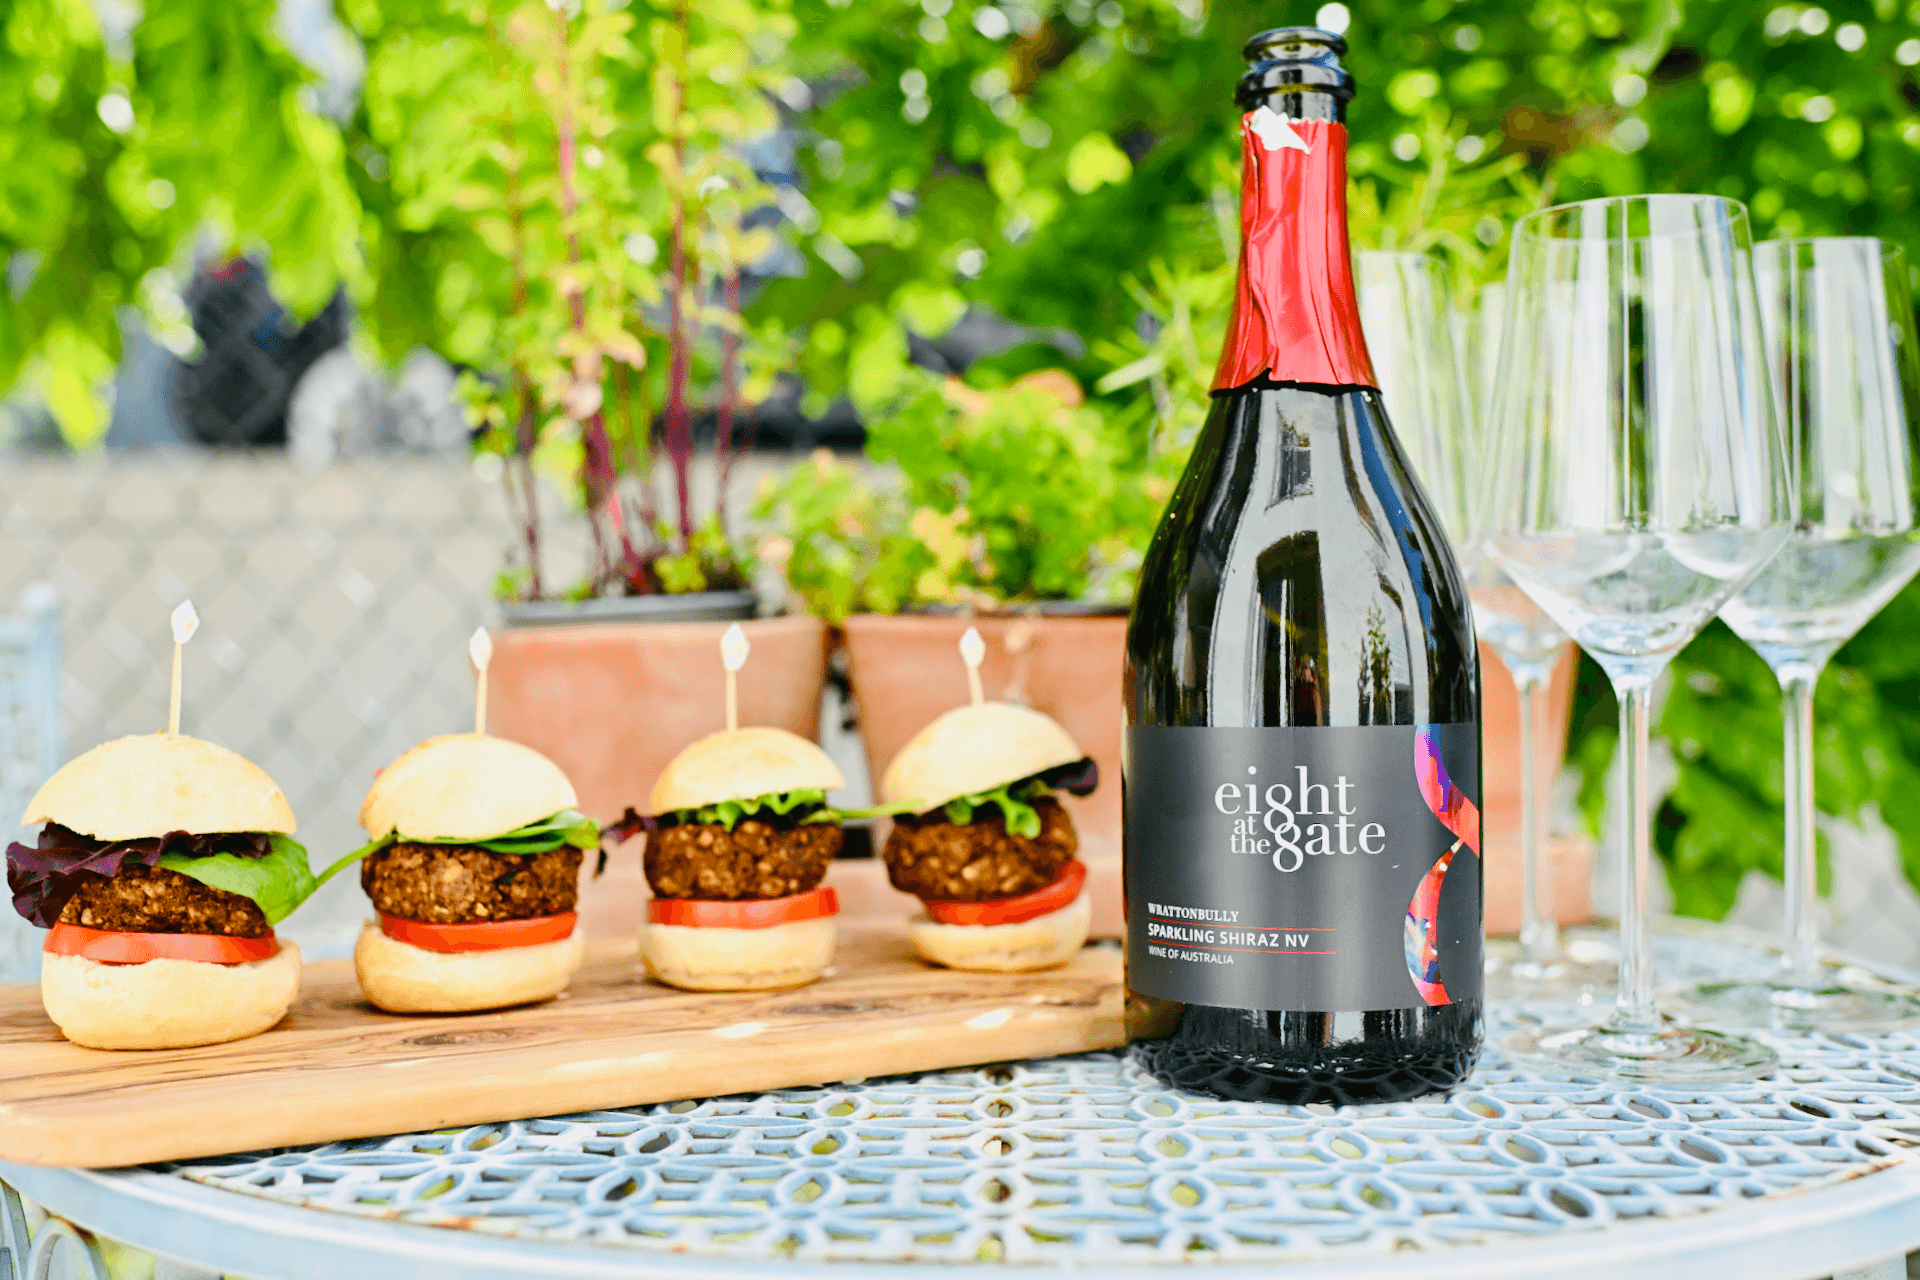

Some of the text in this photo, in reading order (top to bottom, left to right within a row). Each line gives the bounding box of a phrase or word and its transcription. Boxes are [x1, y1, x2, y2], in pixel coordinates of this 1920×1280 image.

[1233, 815, 1258, 835] at
[1230, 834, 1271, 855] the
[1148, 902, 1240, 923] WRATTONBULLY
[1148, 922, 1310, 948] SPARKLING SHIRAZ NV
[1148, 945, 1234, 965] WINE OF AUSTRALIA
